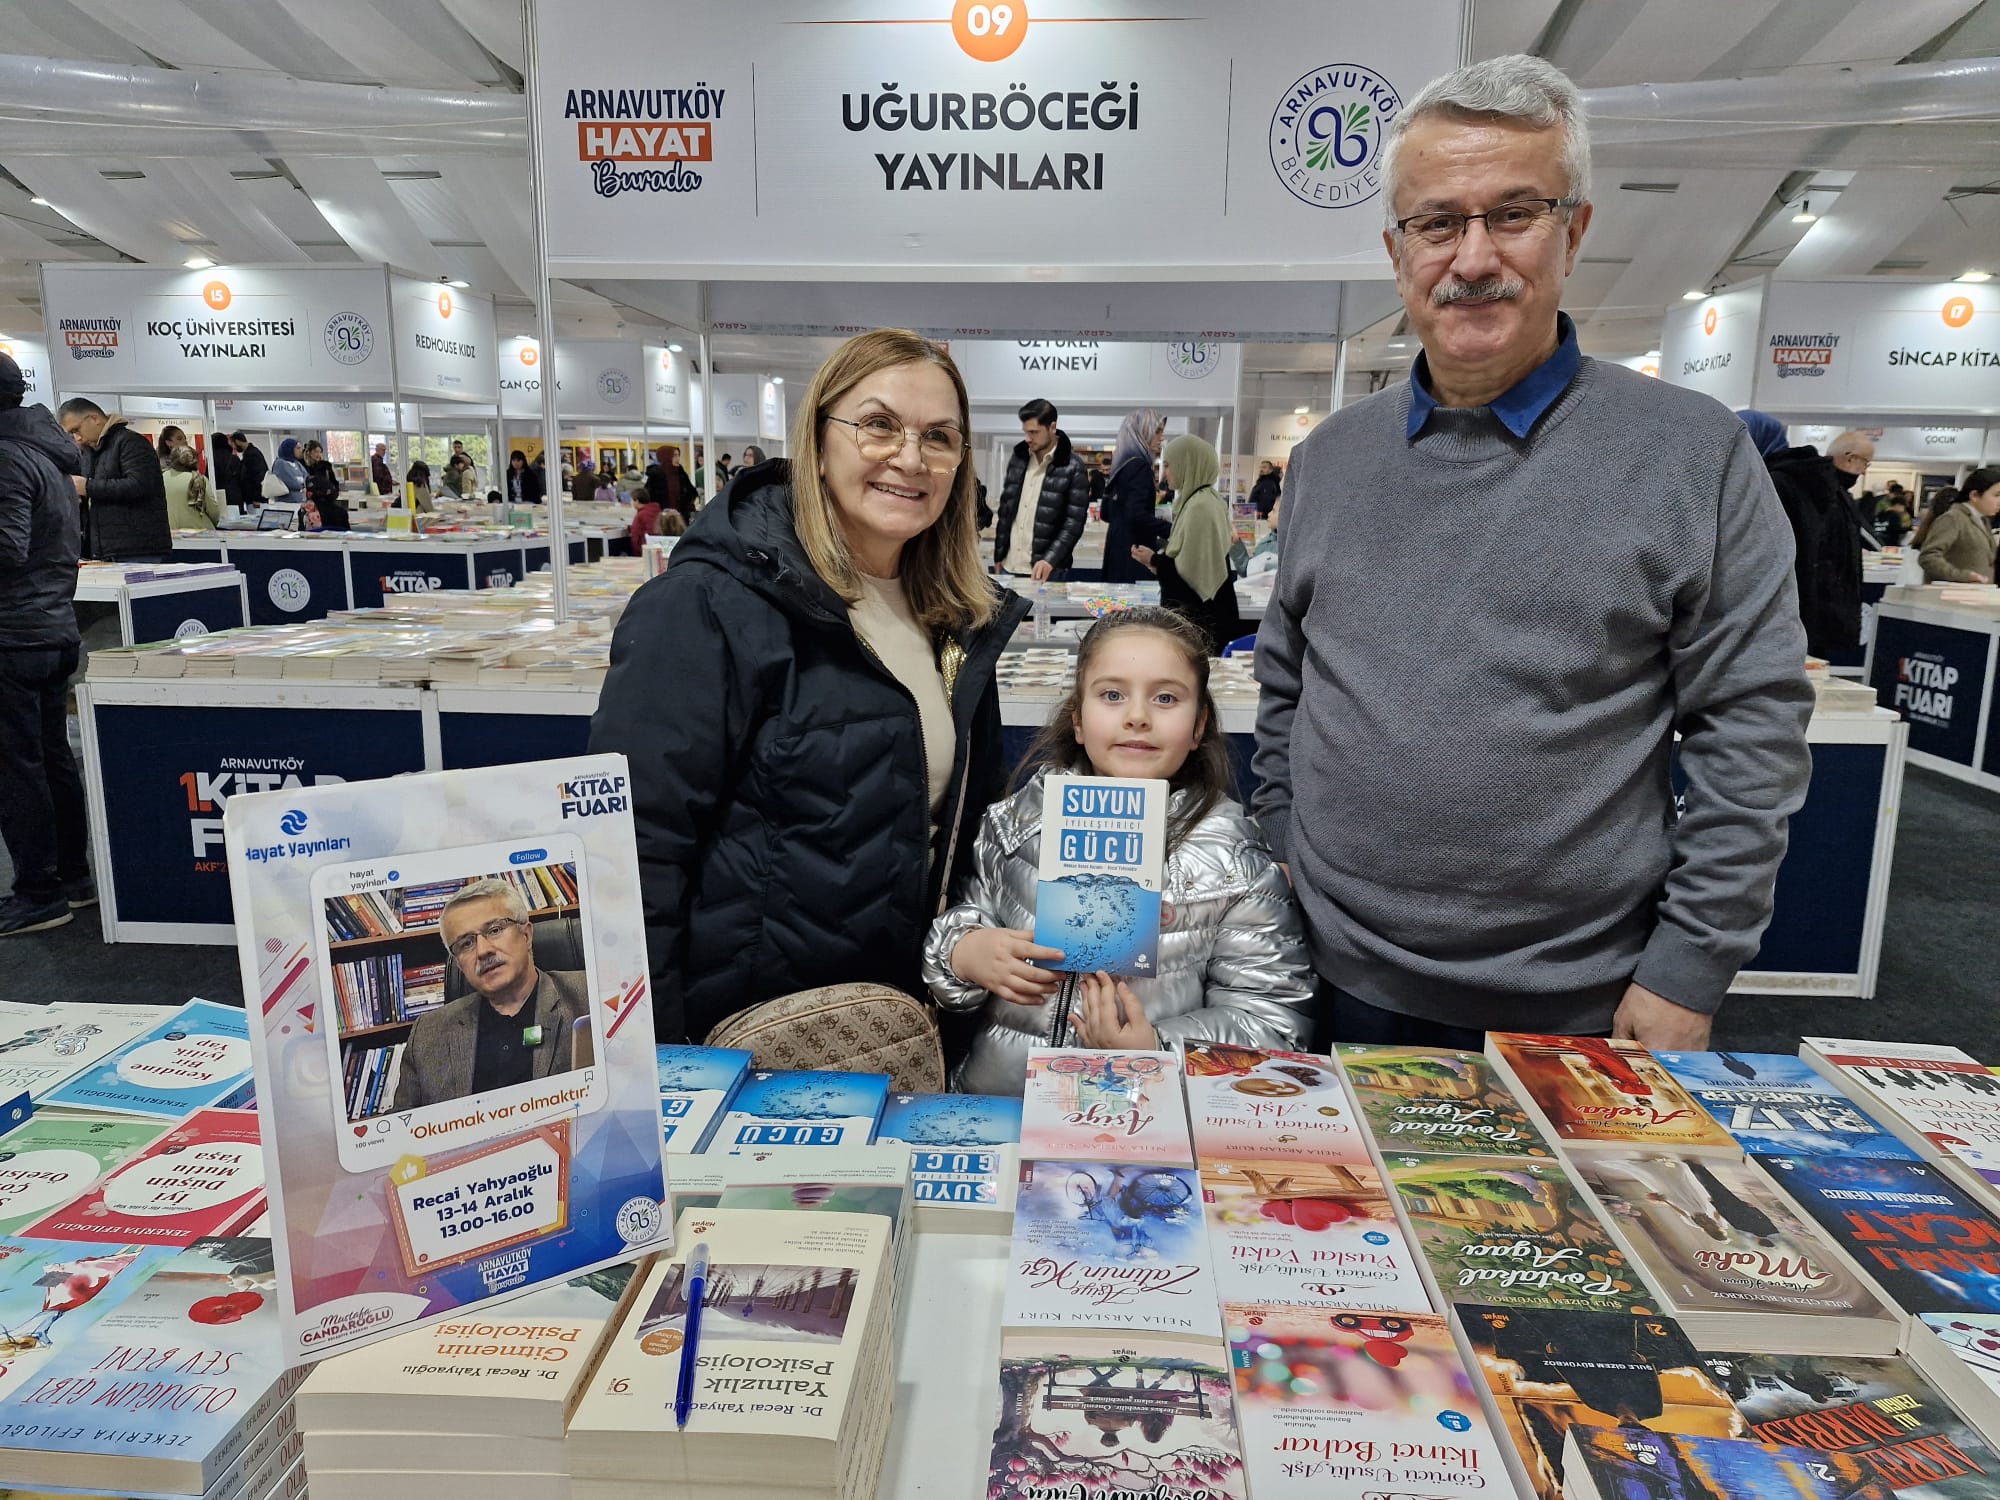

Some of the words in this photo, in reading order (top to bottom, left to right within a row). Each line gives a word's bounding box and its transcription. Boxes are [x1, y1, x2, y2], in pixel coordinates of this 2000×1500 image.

[967, 5, 1012, 36] 09
[565, 82, 725, 119] ARNAVUTKÖY
[842, 81, 1138, 131] UĞURBÖCEĞİ
[586, 127, 705, 157] HAYAT
[591, 159, 702, 198] Burada
[874, 152, 1104, 190] YAYINLARI
[60, 316, 121, 331] ARNAVUTKÖY
[147, 321, 181, 340] KOÇ
[185, 317, 295, 336] ÜNİVERSİTESİ
[69, 332, 116, 345] HAYAT
[415, 333, 457, 355] REDHOUSE
[459, 343, 475, 358] KIDZ
[1769, 332, 1840, 348] ARNAVUTKÖY
[180, 343, 266, 358] YAYINLARI
[1776, 350, 1831, 363] HAYAT
[1889, 347, 1957, 366] SİNCAP
[1019, 352, 1098, 371] YAYINEVİ
[263, 404, 305, 413] YAYINLARI
[220, 757, 304, 770] ARNAVUTKÖY
[562, 796, 627, 819] FUARI
[1066, 788, 1141, 816] SUYUN
[516, 851, 541, 862] Follow
[1064, 832, 1139, 863] GÜCÜ
[349, 869, 374, 880] hayat
[195, 1039, 229, 1050] Yap
[171, 1058, 205, 1069] Bir
[172, 1048, 225, 1062] İyilik
[130, 1063, 214, 1081] Kendine
[72, 1088, 131, 1102] EFİLOĞLU
[131, 1094, 189, 1108] ZEKERİYA
[1700, 1090, 1842, 1106] YÜREKLER
[488, 1105, 516, 1121] var
[1245, 1101, 1306, 1119] Aşk
[1392, 1104, 1495, 1122] Ağacı
[1577, 1104, 1696, 1124] Aşeka
[1062, 1104, 1154, 1136] Asiye
[1204, 1115, 1266, 1130] Usulü
[1274, 1118, 1349, 1134] Görücü
[742, 1126, 839, 1144] GÜCÜ
[1388, 1121, 1521, 1141] Portakal
[194, 1152, 242, 1164] Yaşa
[172, 1164, 241, 1176] Mutlu
[146, 1176, 227, 1190] Düşün
[412, 1186, 460, 1211] Recai
[466, 1163, 553, 1196] Yahyaoğlu
[914, 1182, 990, 1202] SUYU
[152, 1190, 190, 1206] İyi
[436, 1202, 478, 1222] 13-14
[485, 1185, 534, 1208] Aralık
[1819, 1188, 1870, 1202] DENİZCİ
[1870, 1190, 1953, 1206] GENÇOSMAN
[620, 1199, 657, 1222] ARNAVUTKÖY
[51, 1222, 122, 1234] EFİLOĞLU
[440, 1202, 534, 1239] 13.00-16.00
[691, 1220, 716, 1228] Hayat
[124, 1226, 192, 1238] ZEKERİYA
[623, 1219, 658, 1241] BELEDİYESİ
[478, 1248, 532, 1273] ARNAVUTKÖY
[1230, 1245, 1300, 1267] Vakti
[1311, 1249, 1398, 1270] Vuslat
[1458, 1240, 1583, 1268] Ağacı
[485, 1262, 527, 1281] HAYAT
[1018, 1257, 1085, 1289] Kızı
[1239, 1260, 1276, 1278] Aşk
[1277, 1264, 1330, 1282] Usulü
[1694, 1250, 1833, 1280] Mahi
[1080, 1264, 1200, 1294] Zalimin
[1336, 1268, 1398, 1283] Görücü
[1457, 1268, 1620, 1296] Portakal
[1485, 1295, 1550, 1306] BÜYÜKBOZ
[1710, 1290, 1778, 1304] BÜYÜKBOZ
[320, 1306, 372, 1328] Mustafa
[1017, 1311, 1062, 1322] KURT
[1070, 1313, 1134, 1324] ARSLAN
[1142, 1314, 1192, 1327] NEJLA
[1480, 1313, 1510, 1322] Hayat
[433, 1322, 582, 1342] Psikolojisi
[89, 1346, 182, 1374] BENİ
[436, 1344, 569, 1362] Gitmenin
[1112, 1347, 1137, 1356] Hayat
[174, 1350, 243, 1376] SEV
[400, 1364, 482, 1376] Yahyaoğlu
[695, 1354, 834, 1376] Psikolojis
[1542, 1358, 1595, 1369] BÜYÜKBOZ
[1596, 1360, 1627, 1370] GİZEM
[1628, 1362, 1652, 1372] ŞULE
[485, 1367, 530, 1378] Recai
[536, 1368, 560, 1380] Dr.
[16, 1377, 97, 1408] GİBİ
[703, 1378, 829, 1398] Yalnızlık
[89, 1382, 238, 1414] OLDUĞUM
[1871, 1394, 1923, 1414] ZENGİN
[750, 1404, 794, 1415] Recai
[800, 1406, 824, 1416] Dr.
[92, 1428, 192, 1447] ZEKERİYA
[1272, 1438, 1382, 1464] Bahar
[1624, 1440, 1660, 1454] Hayat
[1390, 1442, 1480, 1472] İkinci
[1280, 1460, 1330, 1478] Aşk
[1330, 1466, 1398, 1482] Usulü
[1403, 1469, 1486, 1488] Görücü
